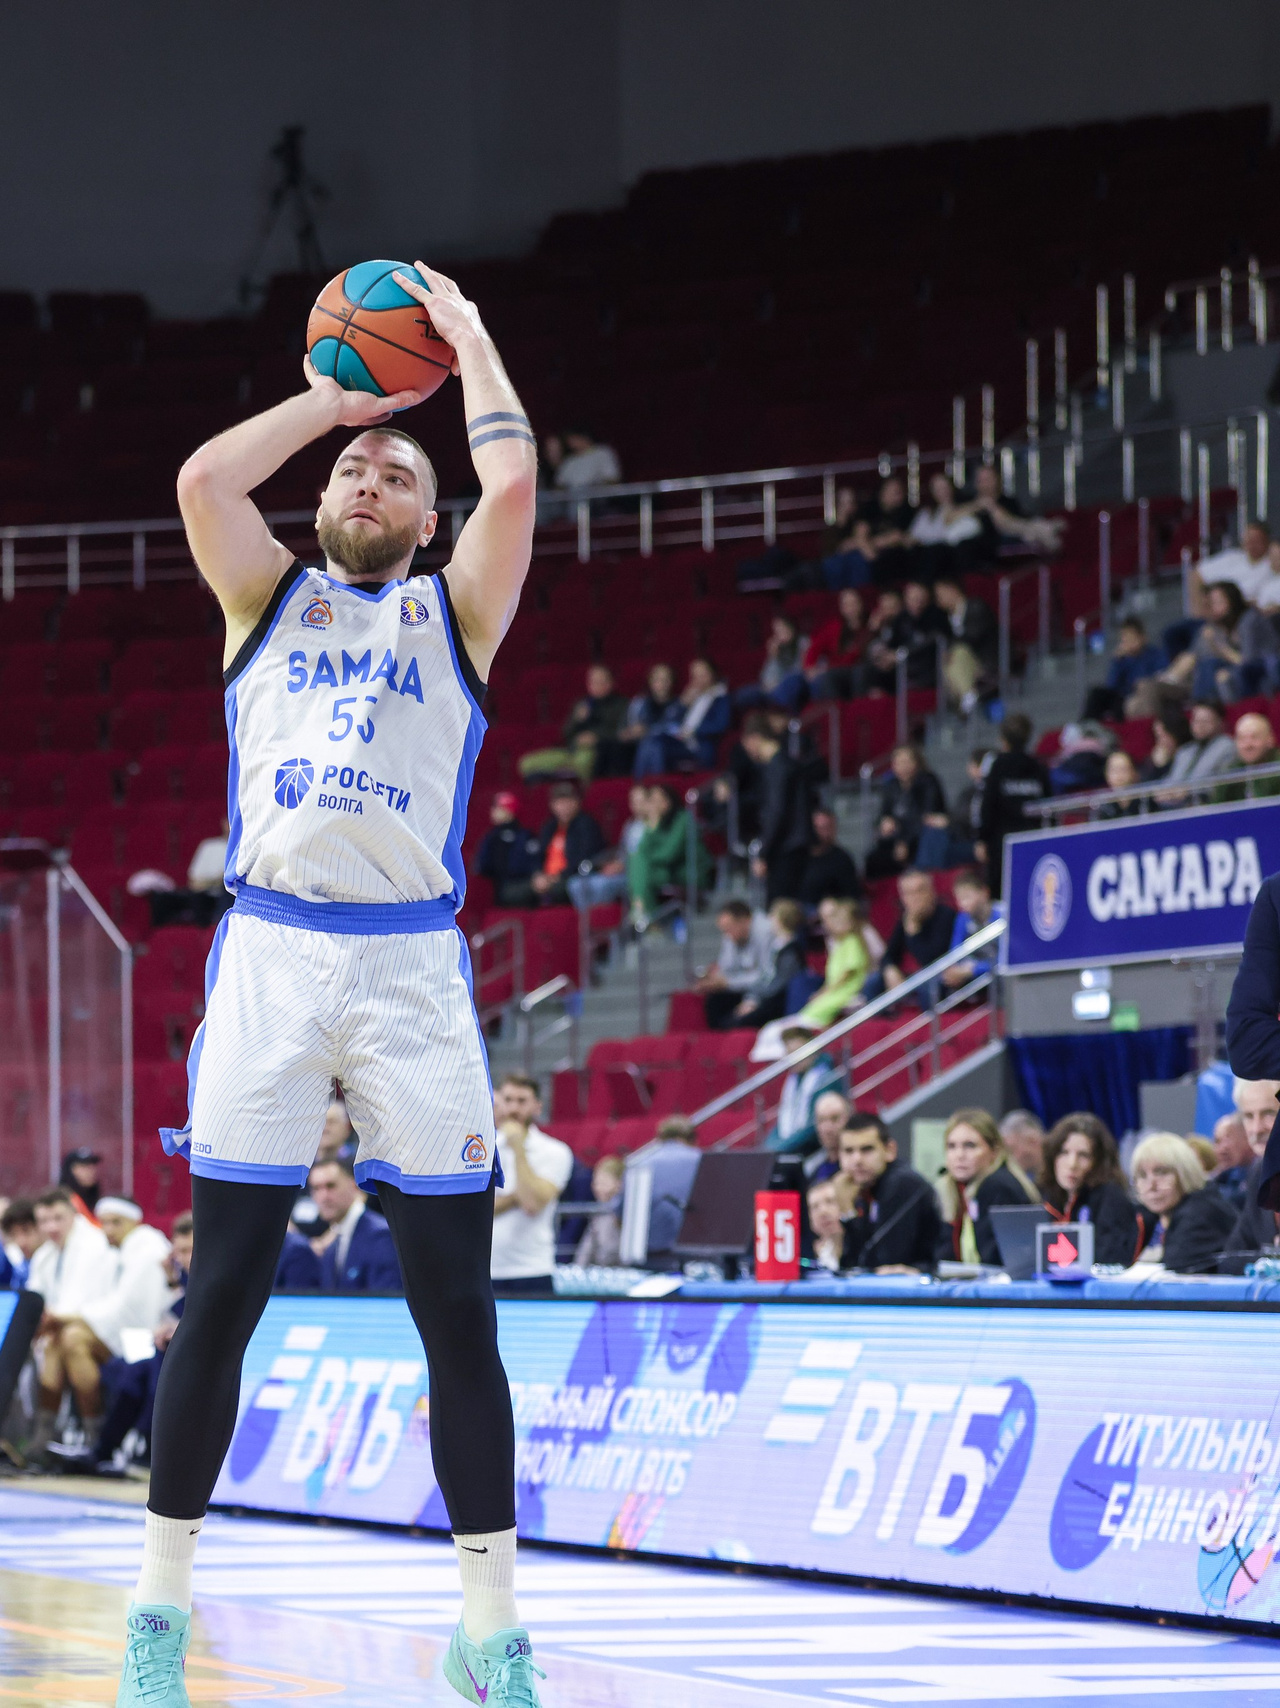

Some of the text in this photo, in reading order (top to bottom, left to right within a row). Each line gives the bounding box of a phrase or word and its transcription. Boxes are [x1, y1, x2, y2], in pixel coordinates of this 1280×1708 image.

[318, 793, 363, 815] ВОЛГА
[1086, 836, 1262, 923] САМАРА
[282, 1356, 424, 1490] ВТБ
[609, 1386, 738, 1438] СПОНСОР
[634, 1449, 692, 1495] ВТБ
[810, 1380, 1013, 1548] ВТБ
[1098, 1474, 1259, 1552] ЕДИНОЙ
